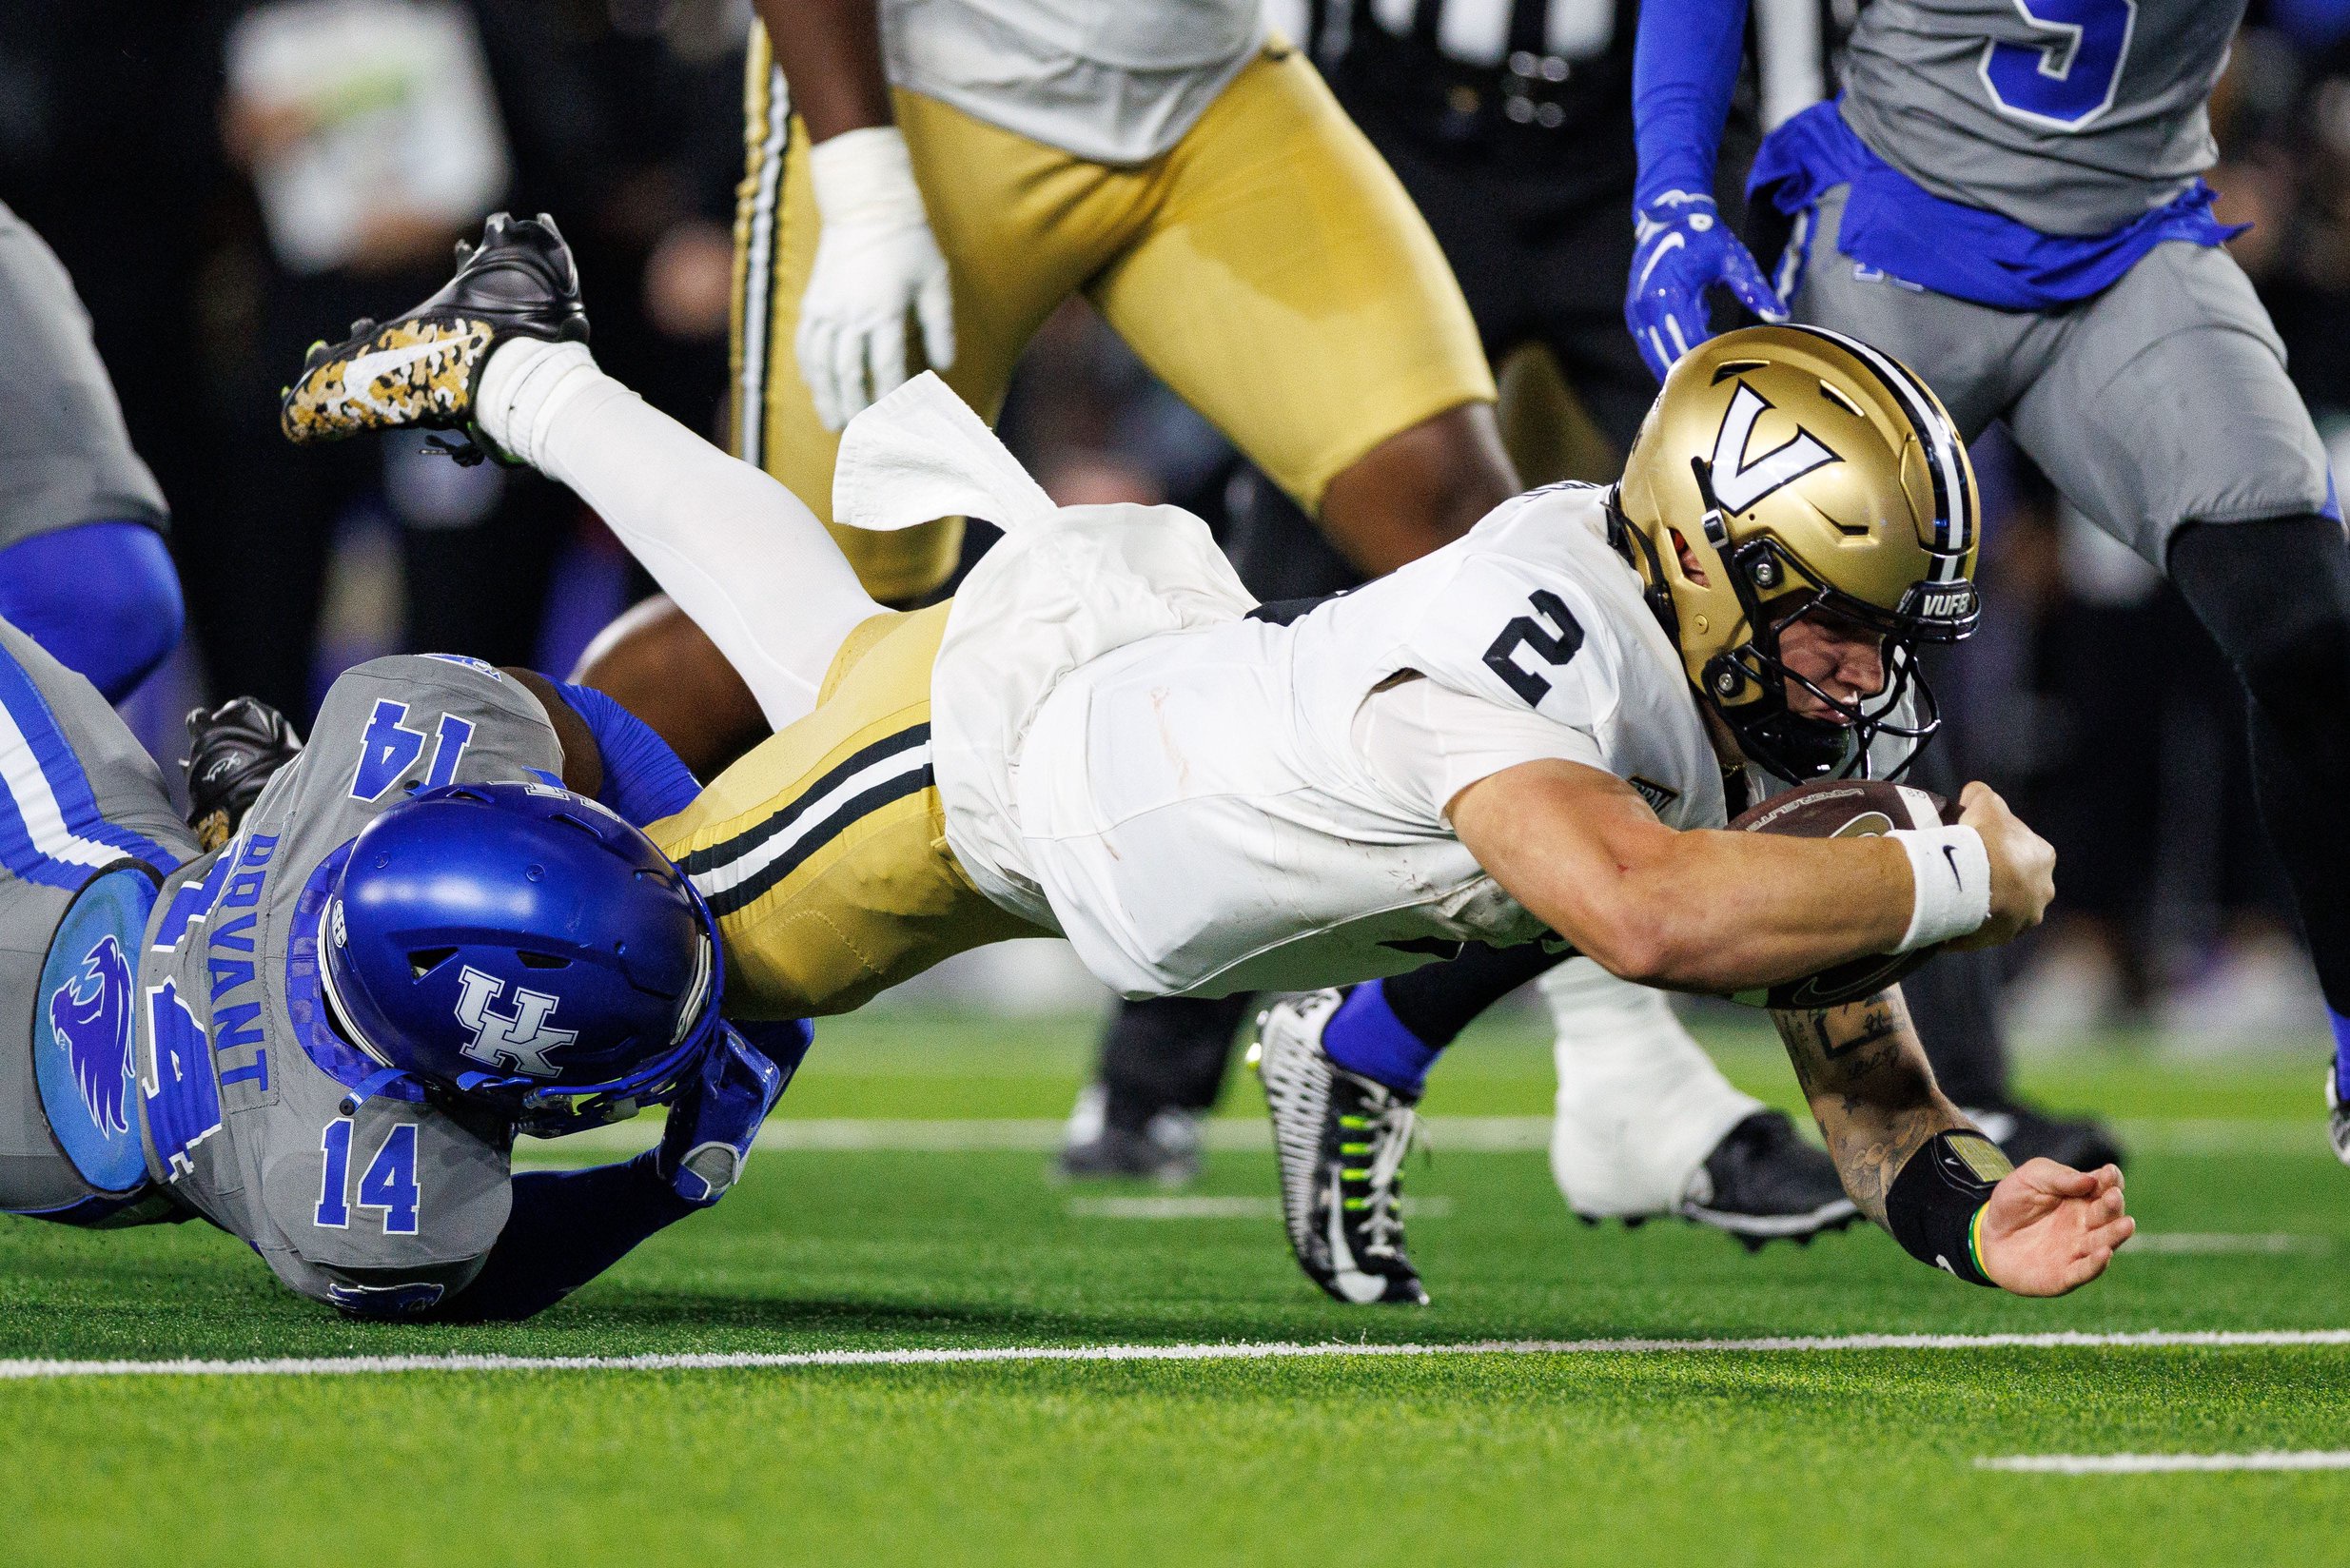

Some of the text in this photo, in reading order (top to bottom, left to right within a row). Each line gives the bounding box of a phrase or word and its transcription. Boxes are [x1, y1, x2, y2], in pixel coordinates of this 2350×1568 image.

[1710, 378, 1846, 518] V
[1481, 588, 1585, 709] 2
[1923, 592, 1971, 617] VUFB
[348, 697, 477, 803] 14
[454, 964, 579, 1079] UK
[314, 1117, 421, 1236] 14
